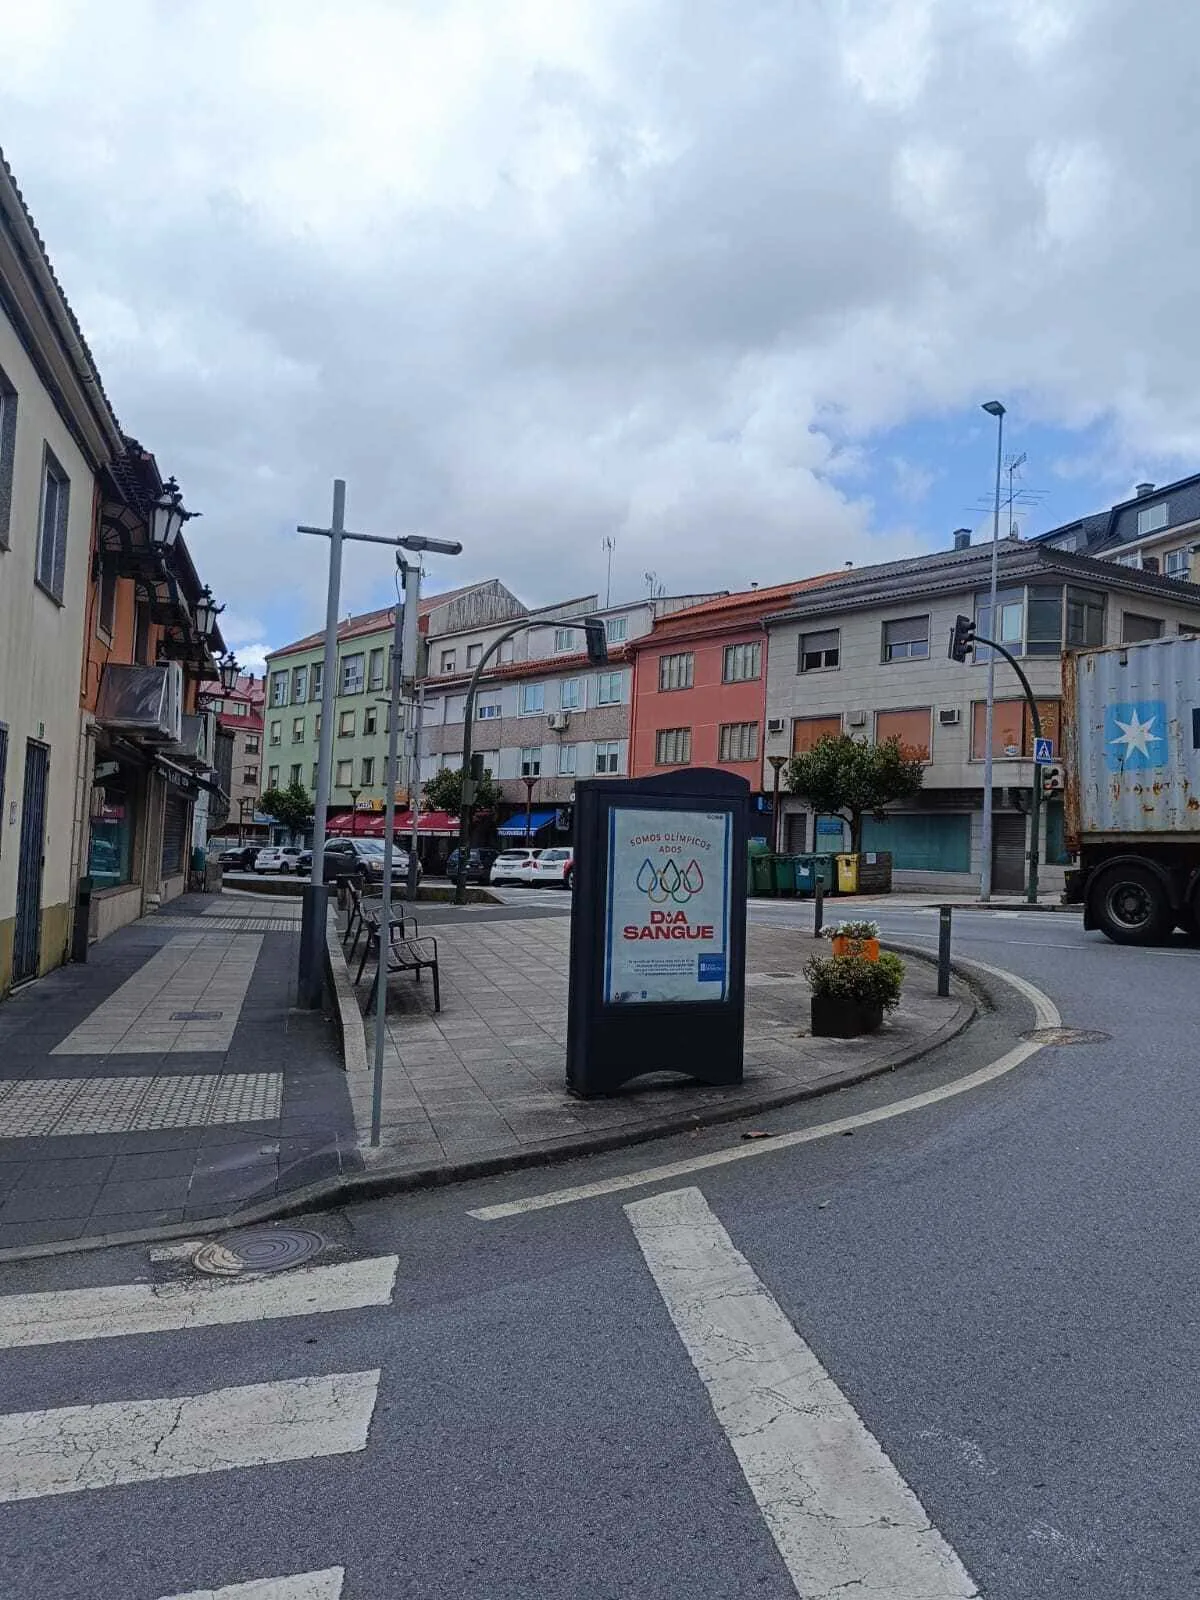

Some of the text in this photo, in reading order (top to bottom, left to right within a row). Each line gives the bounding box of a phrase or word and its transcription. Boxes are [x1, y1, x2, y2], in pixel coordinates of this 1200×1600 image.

[630, 832, 712, 850] SOMOS OLÍMPICOS
[658, 845, 682, 854] ADOS
[623, 925, 714, 940] SANGUE
